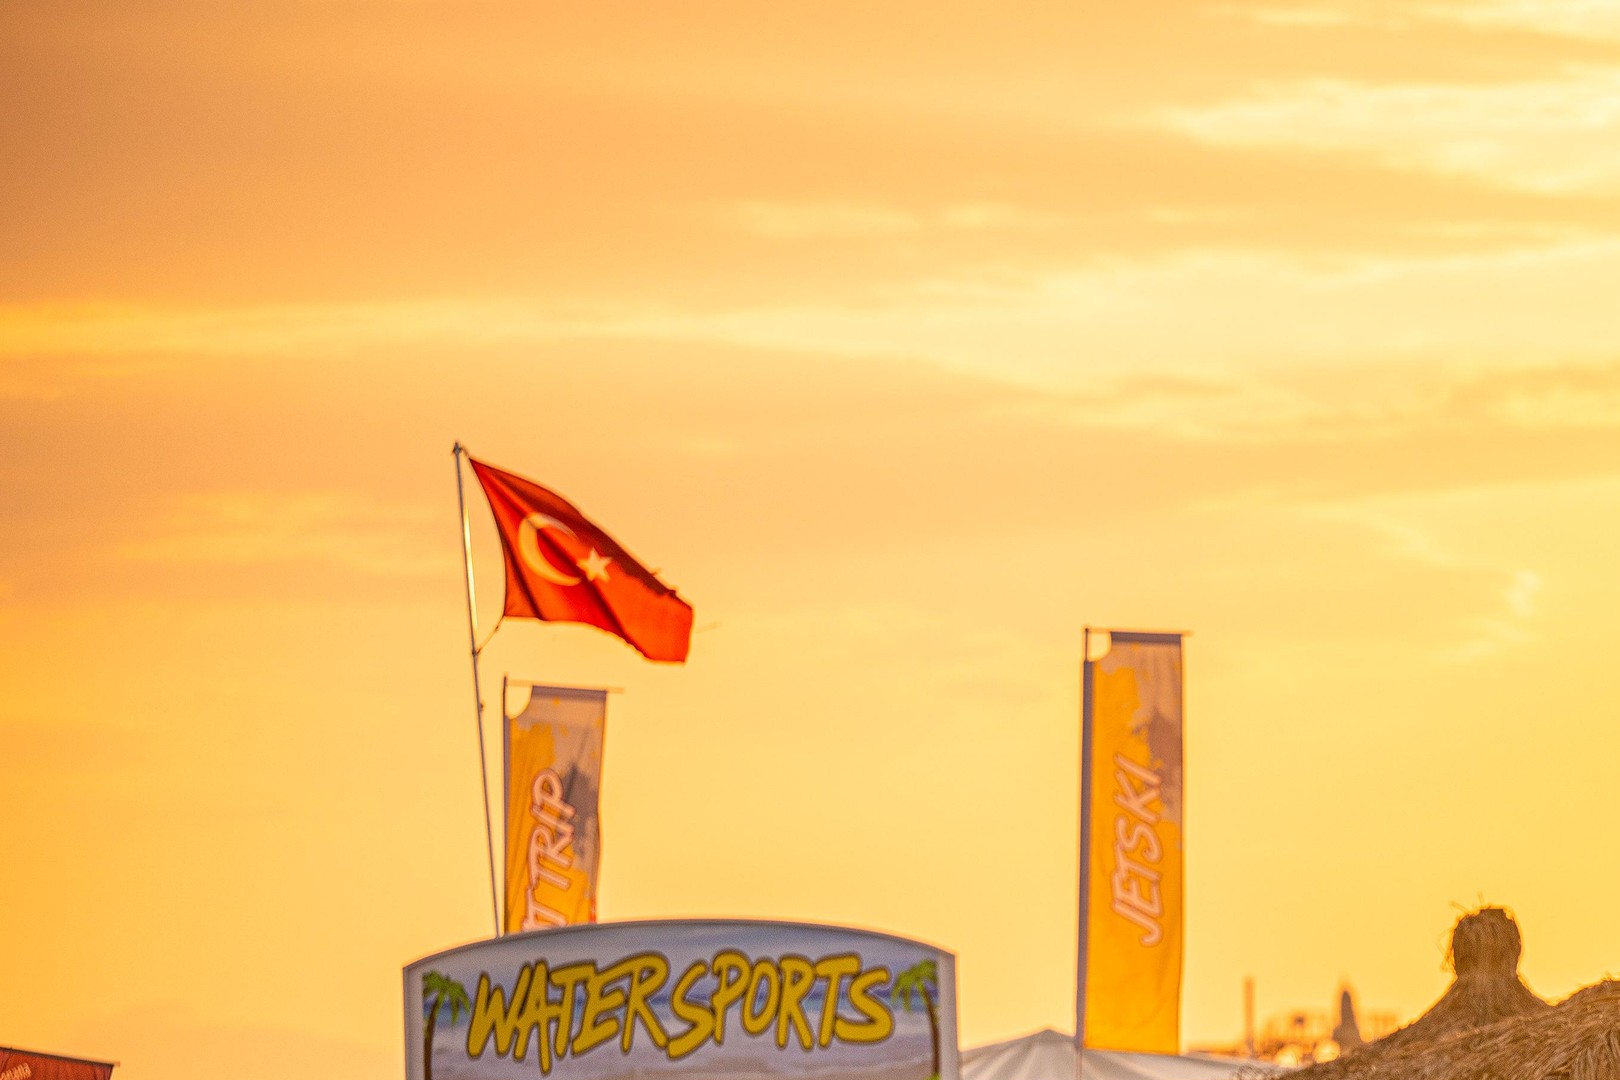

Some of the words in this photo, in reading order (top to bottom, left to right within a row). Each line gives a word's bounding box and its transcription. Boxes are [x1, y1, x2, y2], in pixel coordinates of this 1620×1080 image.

[527, 768, 576, 890] TRIP
[1112, 752, 1163, 946] JETSKI
[466, 948, 894, 1075] WATERSPORTS
